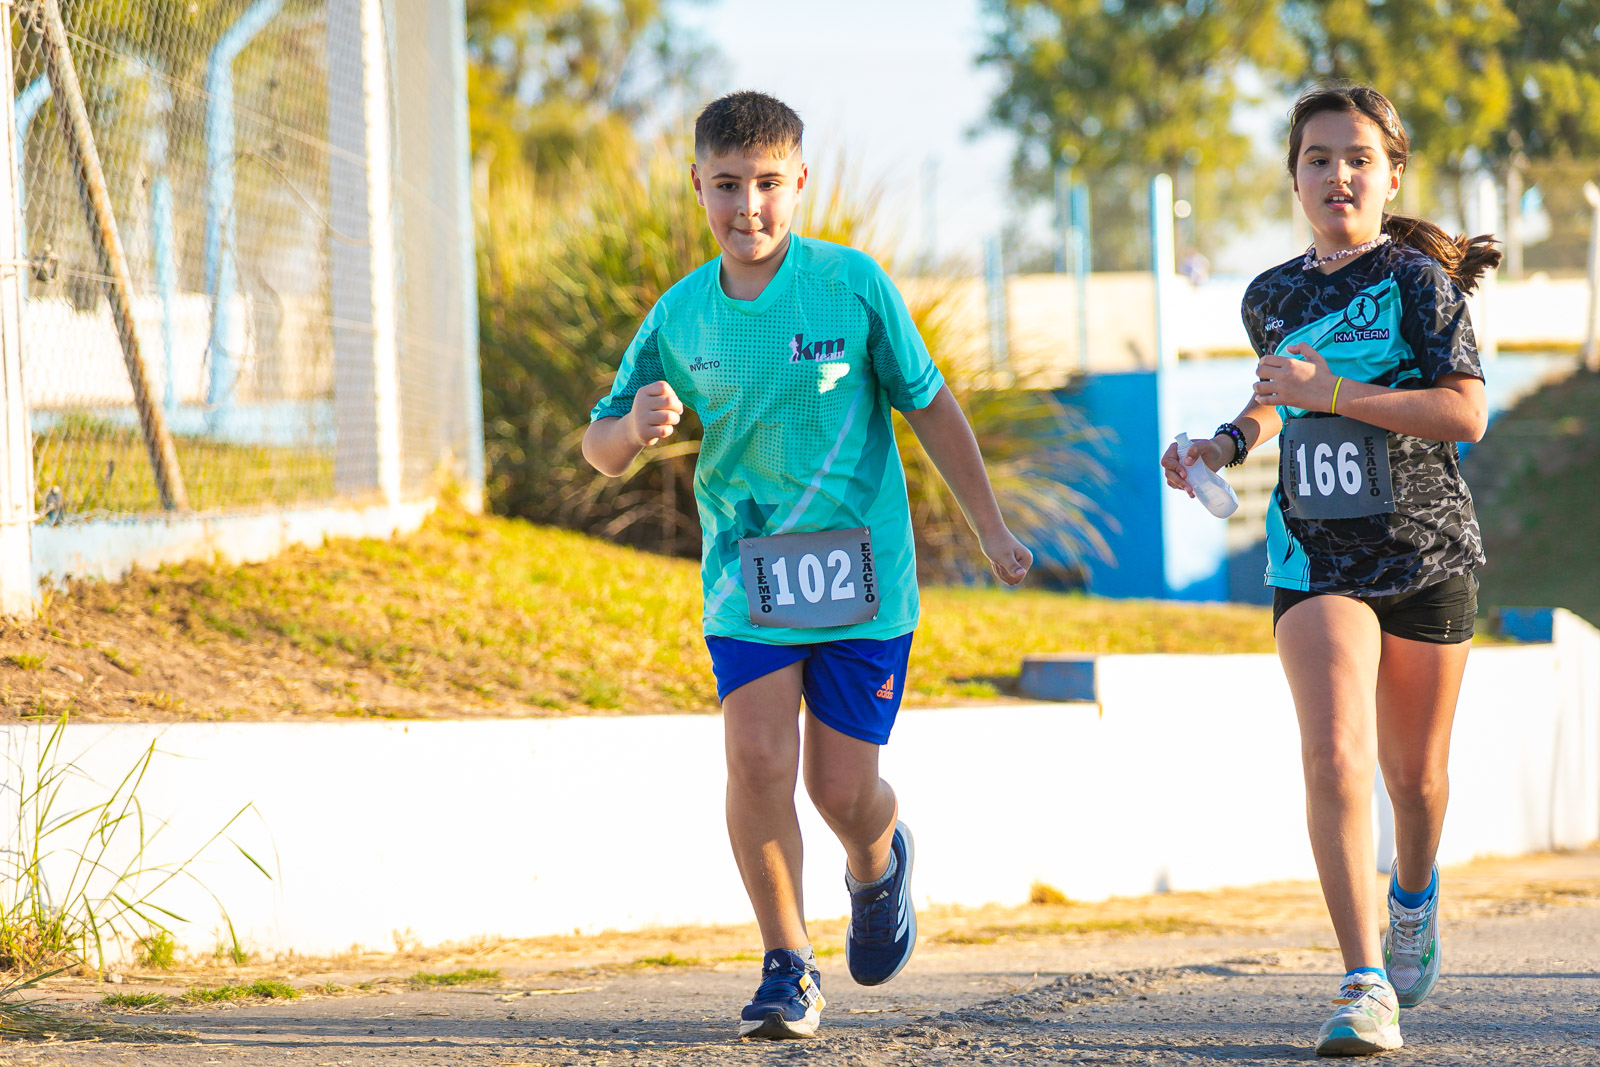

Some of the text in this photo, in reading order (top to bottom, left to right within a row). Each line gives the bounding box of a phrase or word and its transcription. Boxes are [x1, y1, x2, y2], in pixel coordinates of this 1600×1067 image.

[793, 333, 845, 360] km
[1264, 319, 1284, 331] NVICO
[1356, 329, 1389, 340] TEAM
[690, 360, 720, 372] INVICTO
[815, 351, 845, 362] team
[1289, 440, 1297, 501] TIEMPO
[1297, 442, 1362, 496] 166
[1363, 436, 1381, 497] EXACTO
[753, 557, 773, 614] TIEMPO
[771, 549, 856, 606] 102
[860, 542, 876, 604] EXACTO
